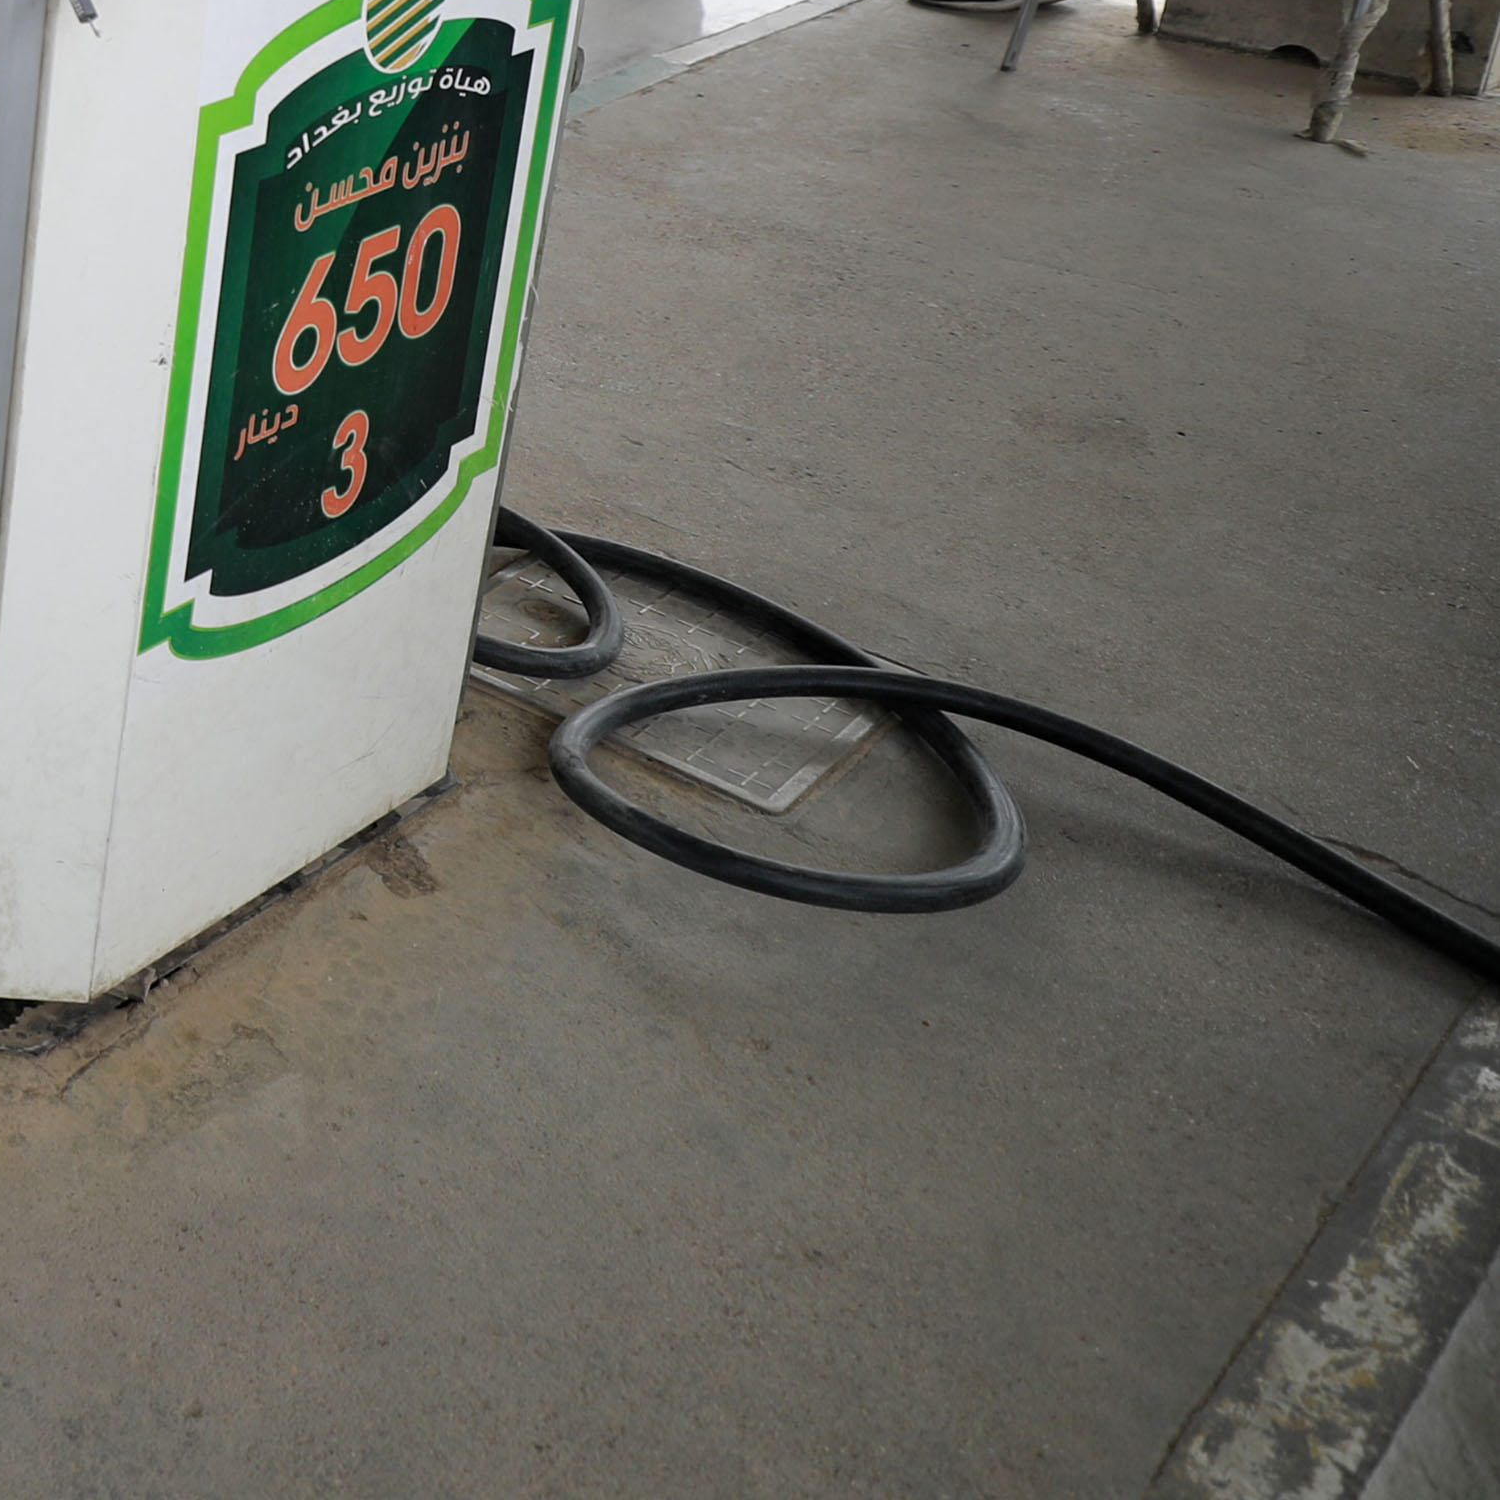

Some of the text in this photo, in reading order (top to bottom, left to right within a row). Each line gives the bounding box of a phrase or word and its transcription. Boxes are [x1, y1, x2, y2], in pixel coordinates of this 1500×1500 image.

[286, 101, 362, 170] بغداد
[367, 68, 437, 117] توزيع
[294, 120, 470, 232] بنزين محسن
[272, 203, 461, 396] 650
[233, 404, 299, 461] دينار
[320, 409, 370, 519] 3
